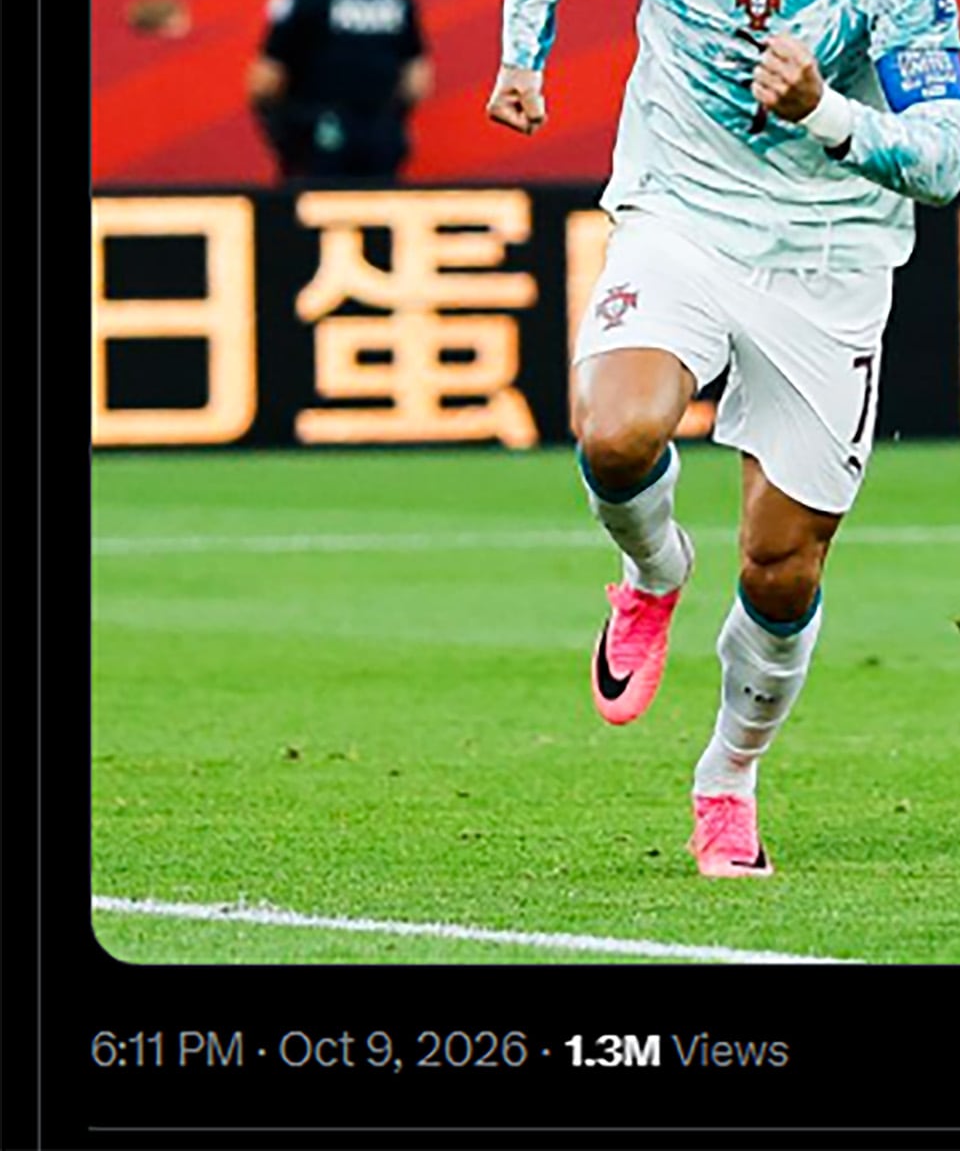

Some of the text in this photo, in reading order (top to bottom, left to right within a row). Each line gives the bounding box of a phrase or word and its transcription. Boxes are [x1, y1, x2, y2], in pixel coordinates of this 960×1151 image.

[852, 353, 875, 444] 7
[90, 1030, 163, 1067] 6:11
[178, 1030, 244, 1067] PM
[278, 1030, 355, 1067] Oct
[365, 1030, 403, 1074] 9,
[416, 1030, 528, 1067] 2026
[564, 1034, 661, 1068] 1.3M
[670, 1031, 789, 1067] Views
